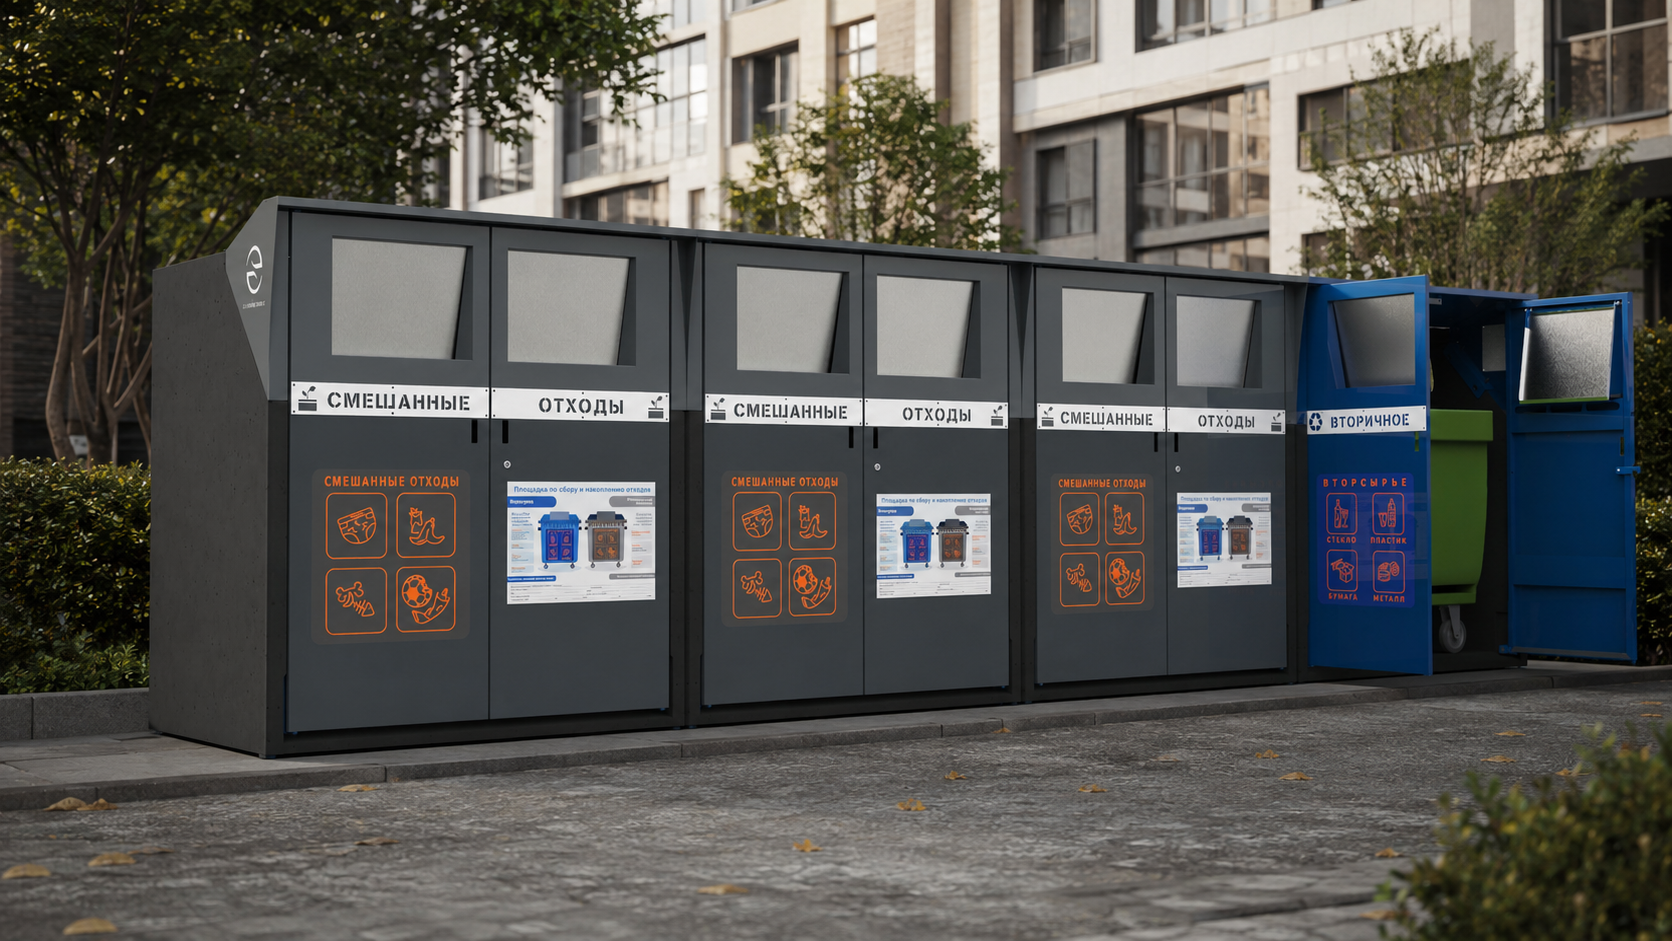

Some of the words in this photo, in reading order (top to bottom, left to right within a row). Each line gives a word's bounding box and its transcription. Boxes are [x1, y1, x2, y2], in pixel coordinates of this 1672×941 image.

[327, 391, 470, 411] СМЕШАННЫЕ
[538, 397, 624, 417] ОТХОДЫ
[733, 403, 848, 420] СМЕШАННЫЕ
[902, 407, 971, 424] ОТХОДЫ
[1060, 411, 1153, 426] СМЕШАННЫЕ
[1198, 414, 1255, 430] ОТХОДЫ
[1330, 413, 1410, 429] ВТОРИЧНОЕ
[324, 475, 405, 488] СМЕШАННЫЕ
[409, 475, 459, 489] ОТХОДЫ
[731, 476, 796, 487] СМЕШАННЫЕ
[799, 476, 839, 489] ОТХОДЫ
[1058, 478, 1111, 488] СМЕШАННЫЕ
[1113, 478, 1146, 489] ОТХОДЫ
[1323, 477, 1407, 488] ВТОРСЫРЬЕ
[558, 485, 578, 494] сбору
[1328, 592, 1358, 601] БУМАГА
